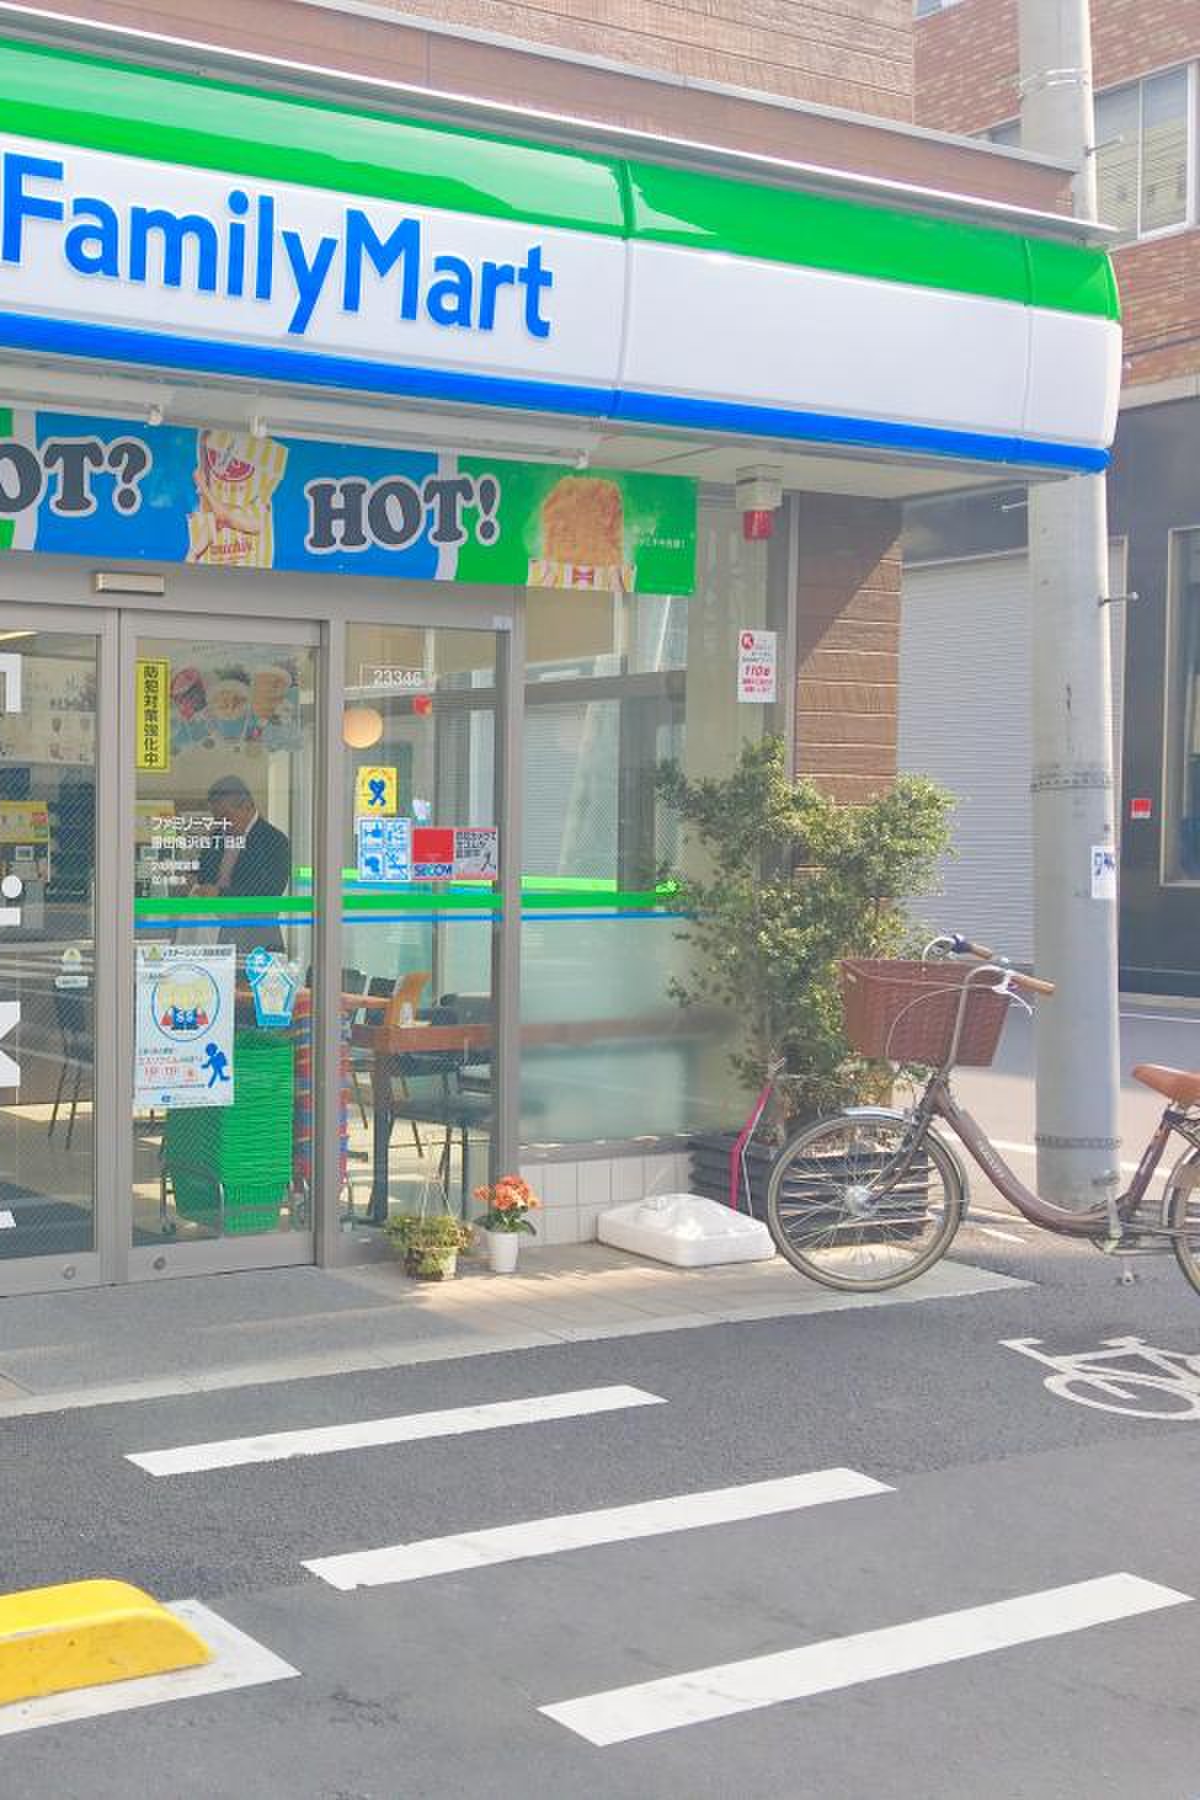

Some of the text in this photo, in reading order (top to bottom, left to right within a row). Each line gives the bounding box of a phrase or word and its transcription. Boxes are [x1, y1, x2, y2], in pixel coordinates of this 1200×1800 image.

[1, 152, 553, 338] FamilyMart
[307, 480, 497, 549] HOT!
[143, 665, 159, 767] 防犯対策強化中
[151, 816, 233, 832] ファミリーマート
[414, 863, 453, 877] SECOM
